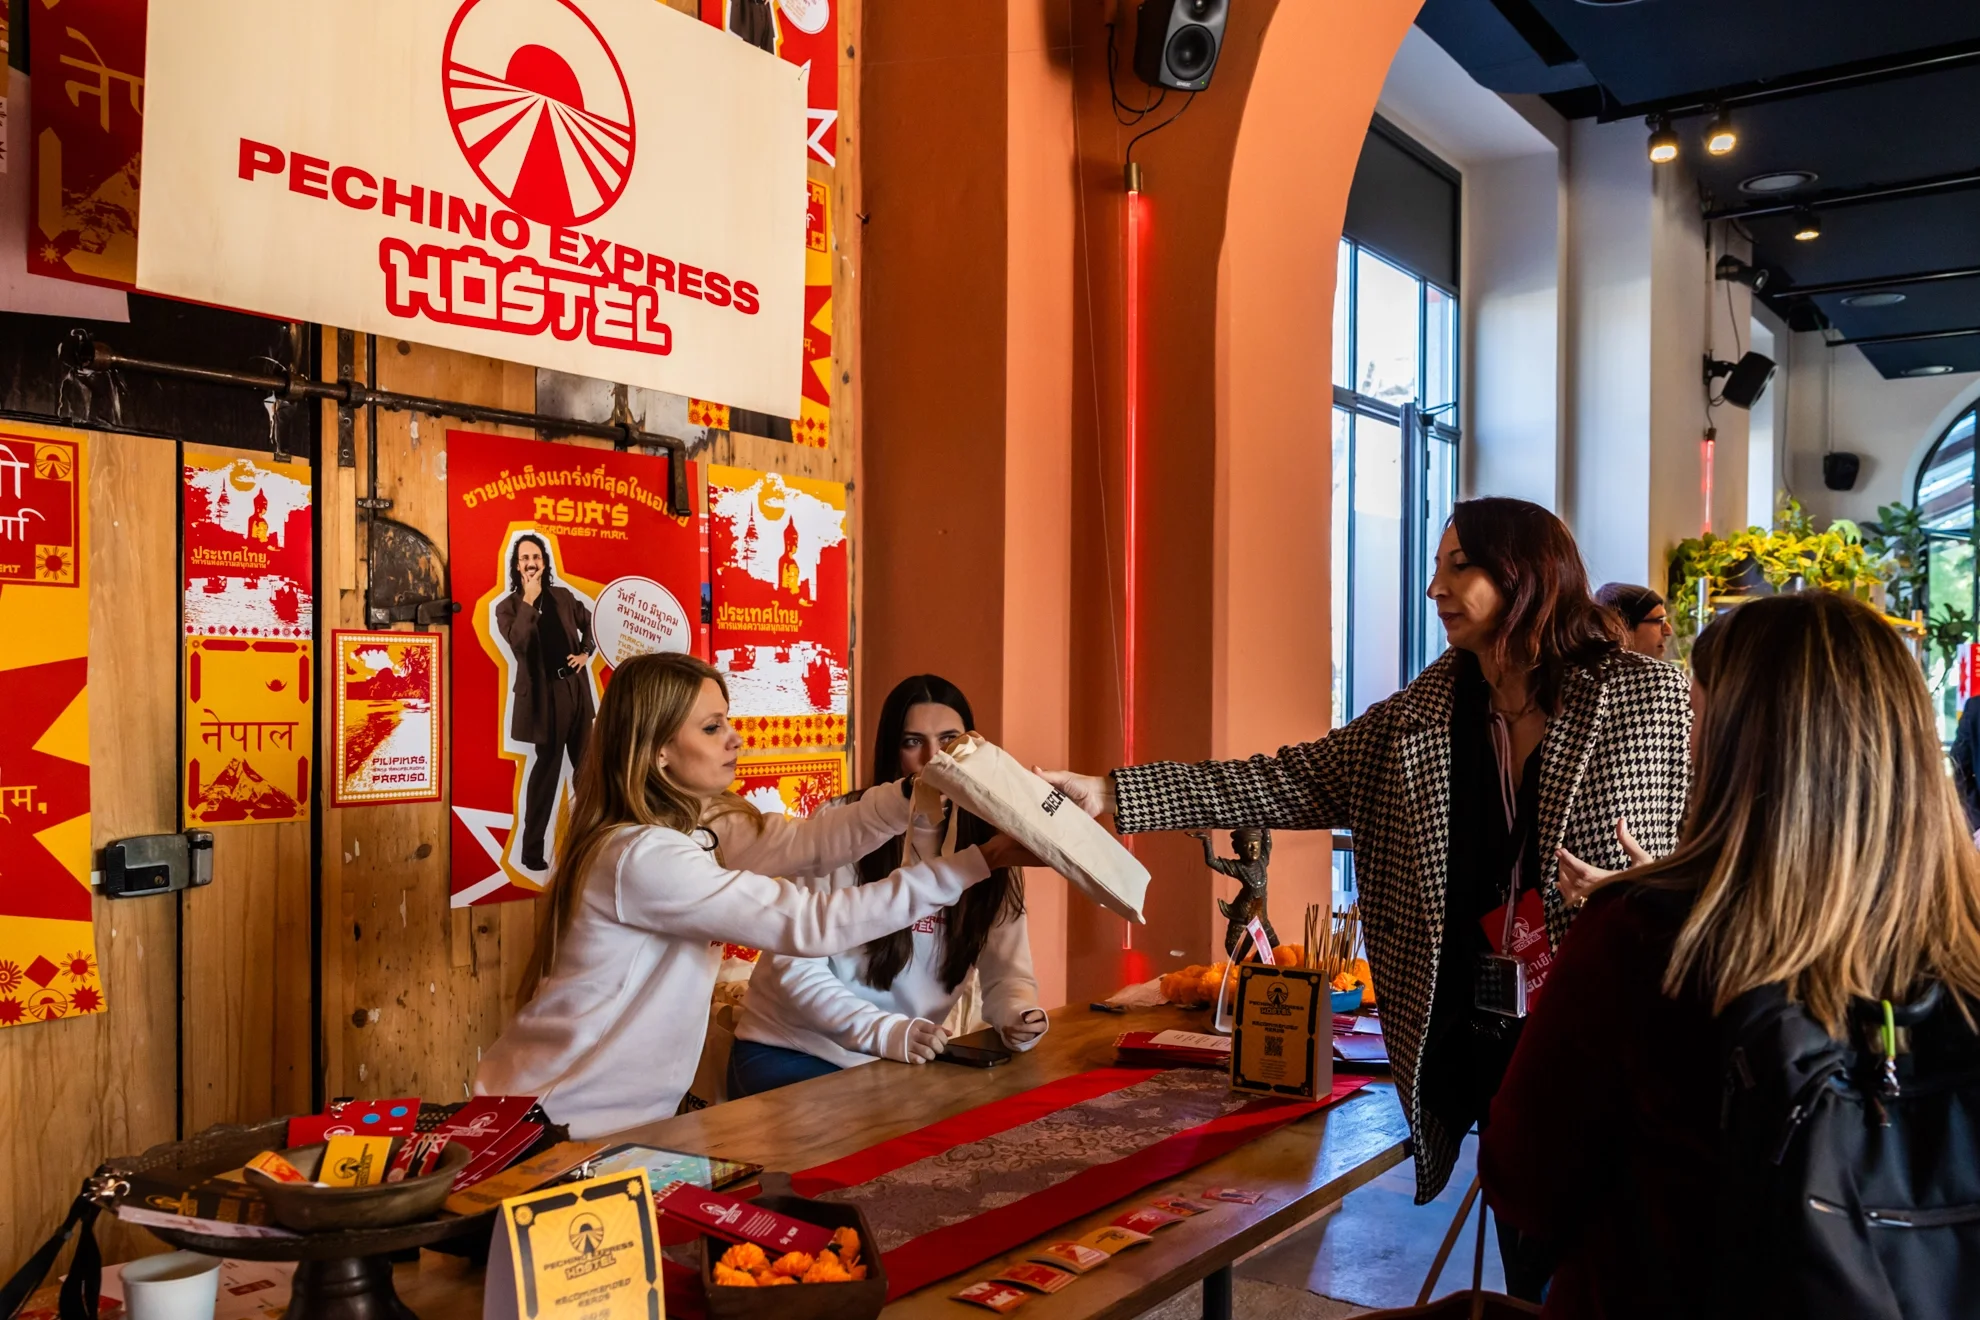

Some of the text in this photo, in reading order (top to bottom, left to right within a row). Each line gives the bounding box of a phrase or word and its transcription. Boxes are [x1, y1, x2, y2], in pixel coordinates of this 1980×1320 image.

[238, 137, 760, 315] PECHINO EXPRESS
[379, 236, 672, 356] HOSTEL
[462, 464, 690, 528] ชายผู้แข็งแกร่งที่สุดในเอเย
[533, 495, 629, 527] ASIA'S
[535, 523, 598, 538] STRONGEST
[638, 599, 648, 612] 10
[200, 708, 299, 752] नेपाल
[372, 772, 428, 783] PARAISO.
[564, 1254, 617, 1280] HOSTEL
